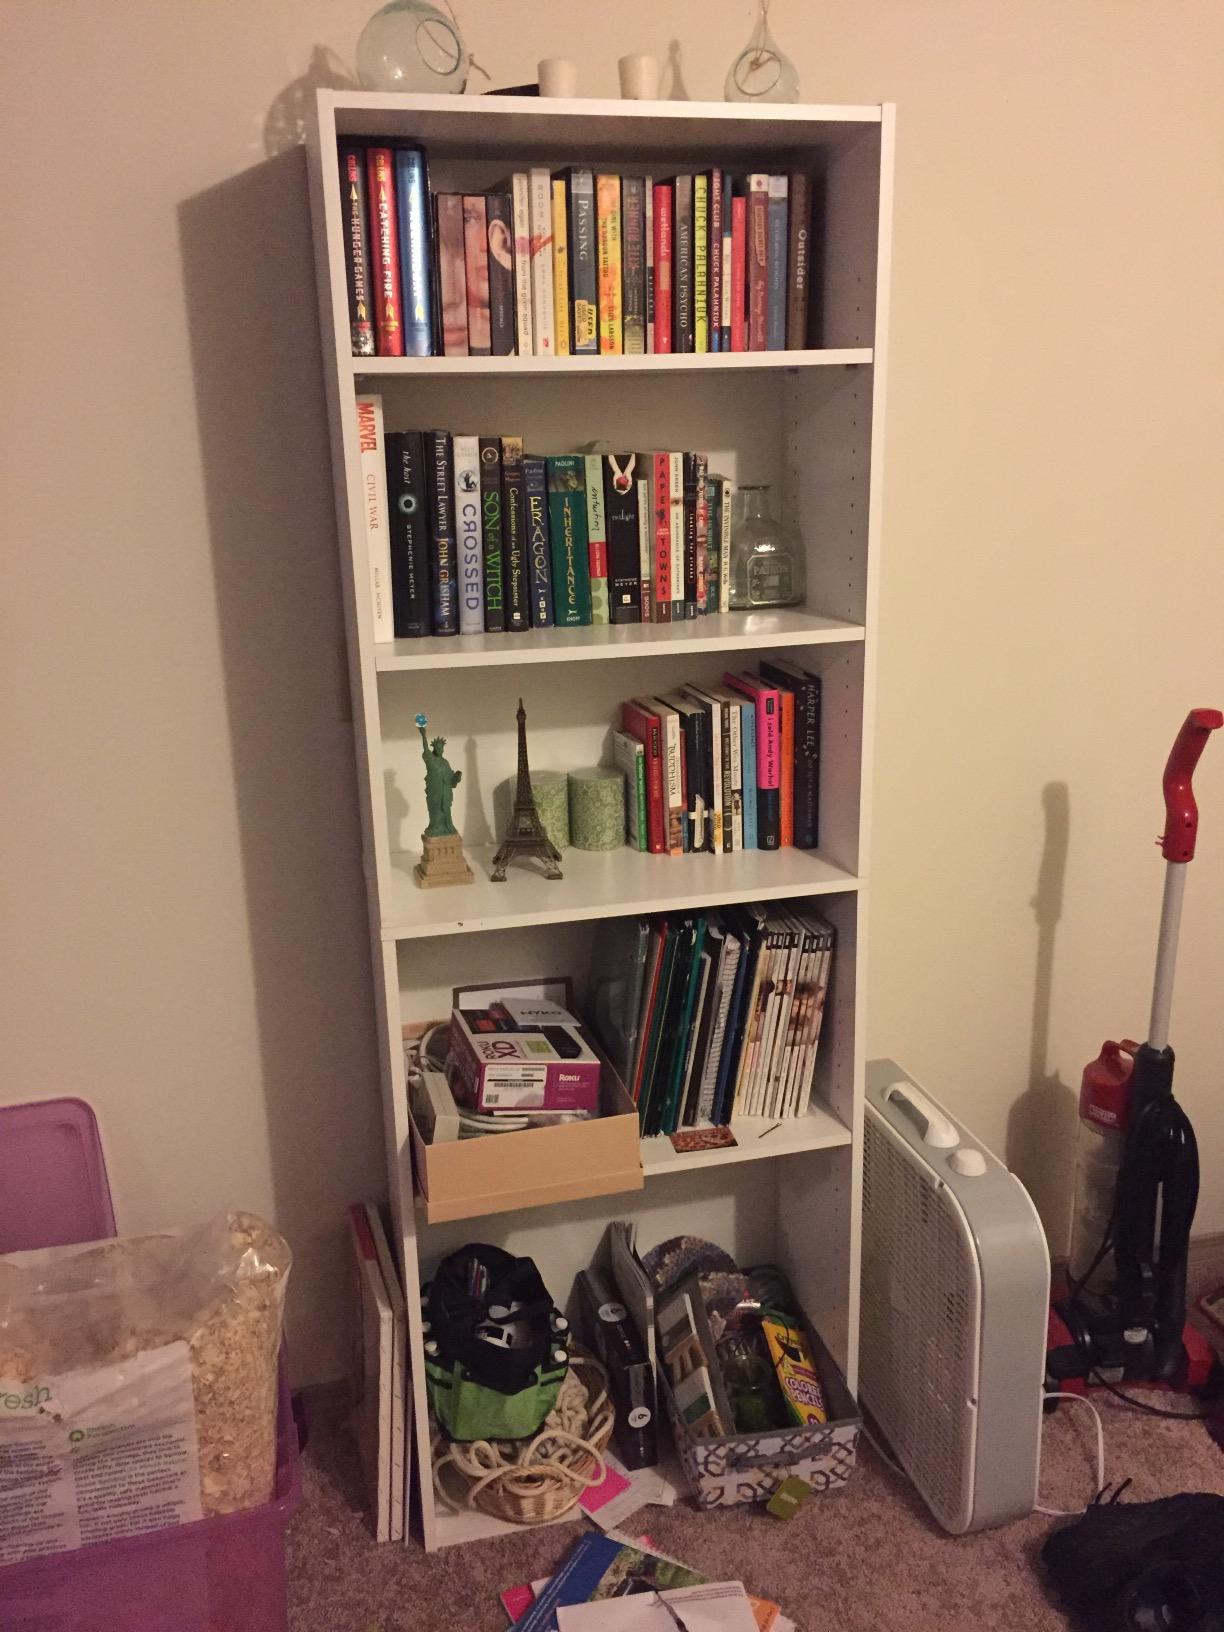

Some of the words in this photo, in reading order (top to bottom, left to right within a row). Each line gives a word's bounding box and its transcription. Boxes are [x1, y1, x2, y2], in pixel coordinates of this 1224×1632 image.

[347, 154, 358, 183] COLLINS
[375, 154, 387, 182] COLLINS
[350, 201, 358, 217] THE
[537, 184, 546, 219] ROOM
[696, 187, 706, 232] CHUCK
[351, 217, 362, 263] HUNGER
[378, 202, 394, 265] CATCHING
[578, 198, 589, 261] PASSING
[660, 207, 669, 257] wetlands
[679, 224, 688, 280] AMERICAN
[796, 229, 807, 290] Outsider
[354, 265, 365, 301] GAMES
[384, 270, 394, 299] FIRE
[696, 245, 706, 323] PALAHNIUK
[522, 312, 531, 336] squad
[680, 284, 688, 328] PSYCHO
[356, 402, 378, 454] MARVEL
[434, 437, 446, 457] THE
[365, 473, 377, 504] CIVIL
[402, 467, 410, 485] host
[435, 458, 446, 493] STREET
[367, 504, 379, 531] WAR
[437, 495, 448, 531] LAWYER
[484, 491, 500, 535] SON
[509, 487, 519, 535] Confessions
[591, 486, 601, 531] intuition
[611, 509, 635, 522] twilight
[406, 523, 414, 569] STEPHENIE
[436, 537, 448, 568] JOHN
[462, 503, 479, 610] CROSSED
[512, 550, 521, 568] Ugly
[528, 496, 549, 584] ERAGON
[563, 497, 576, 605] INHERITANCE
[408, 572, 416, 599] MEYER
[485, 550, 502, 611] WITCH
[659, 538, 668, 596] TOWNS
[438, 569, 450, 617] GRISHAM
[513, 569, 521, 606] Stepsister
[806, 684, 817, 724] HARPER
[806, 730, 815, 747] LEE
[669, 743, 677, 796] BUDDHISM
[723, 770, 731, 806] REVOLUTION
[491, 1040, 521, 1059] XD
[559, 1073, 580, 1081] Roku
